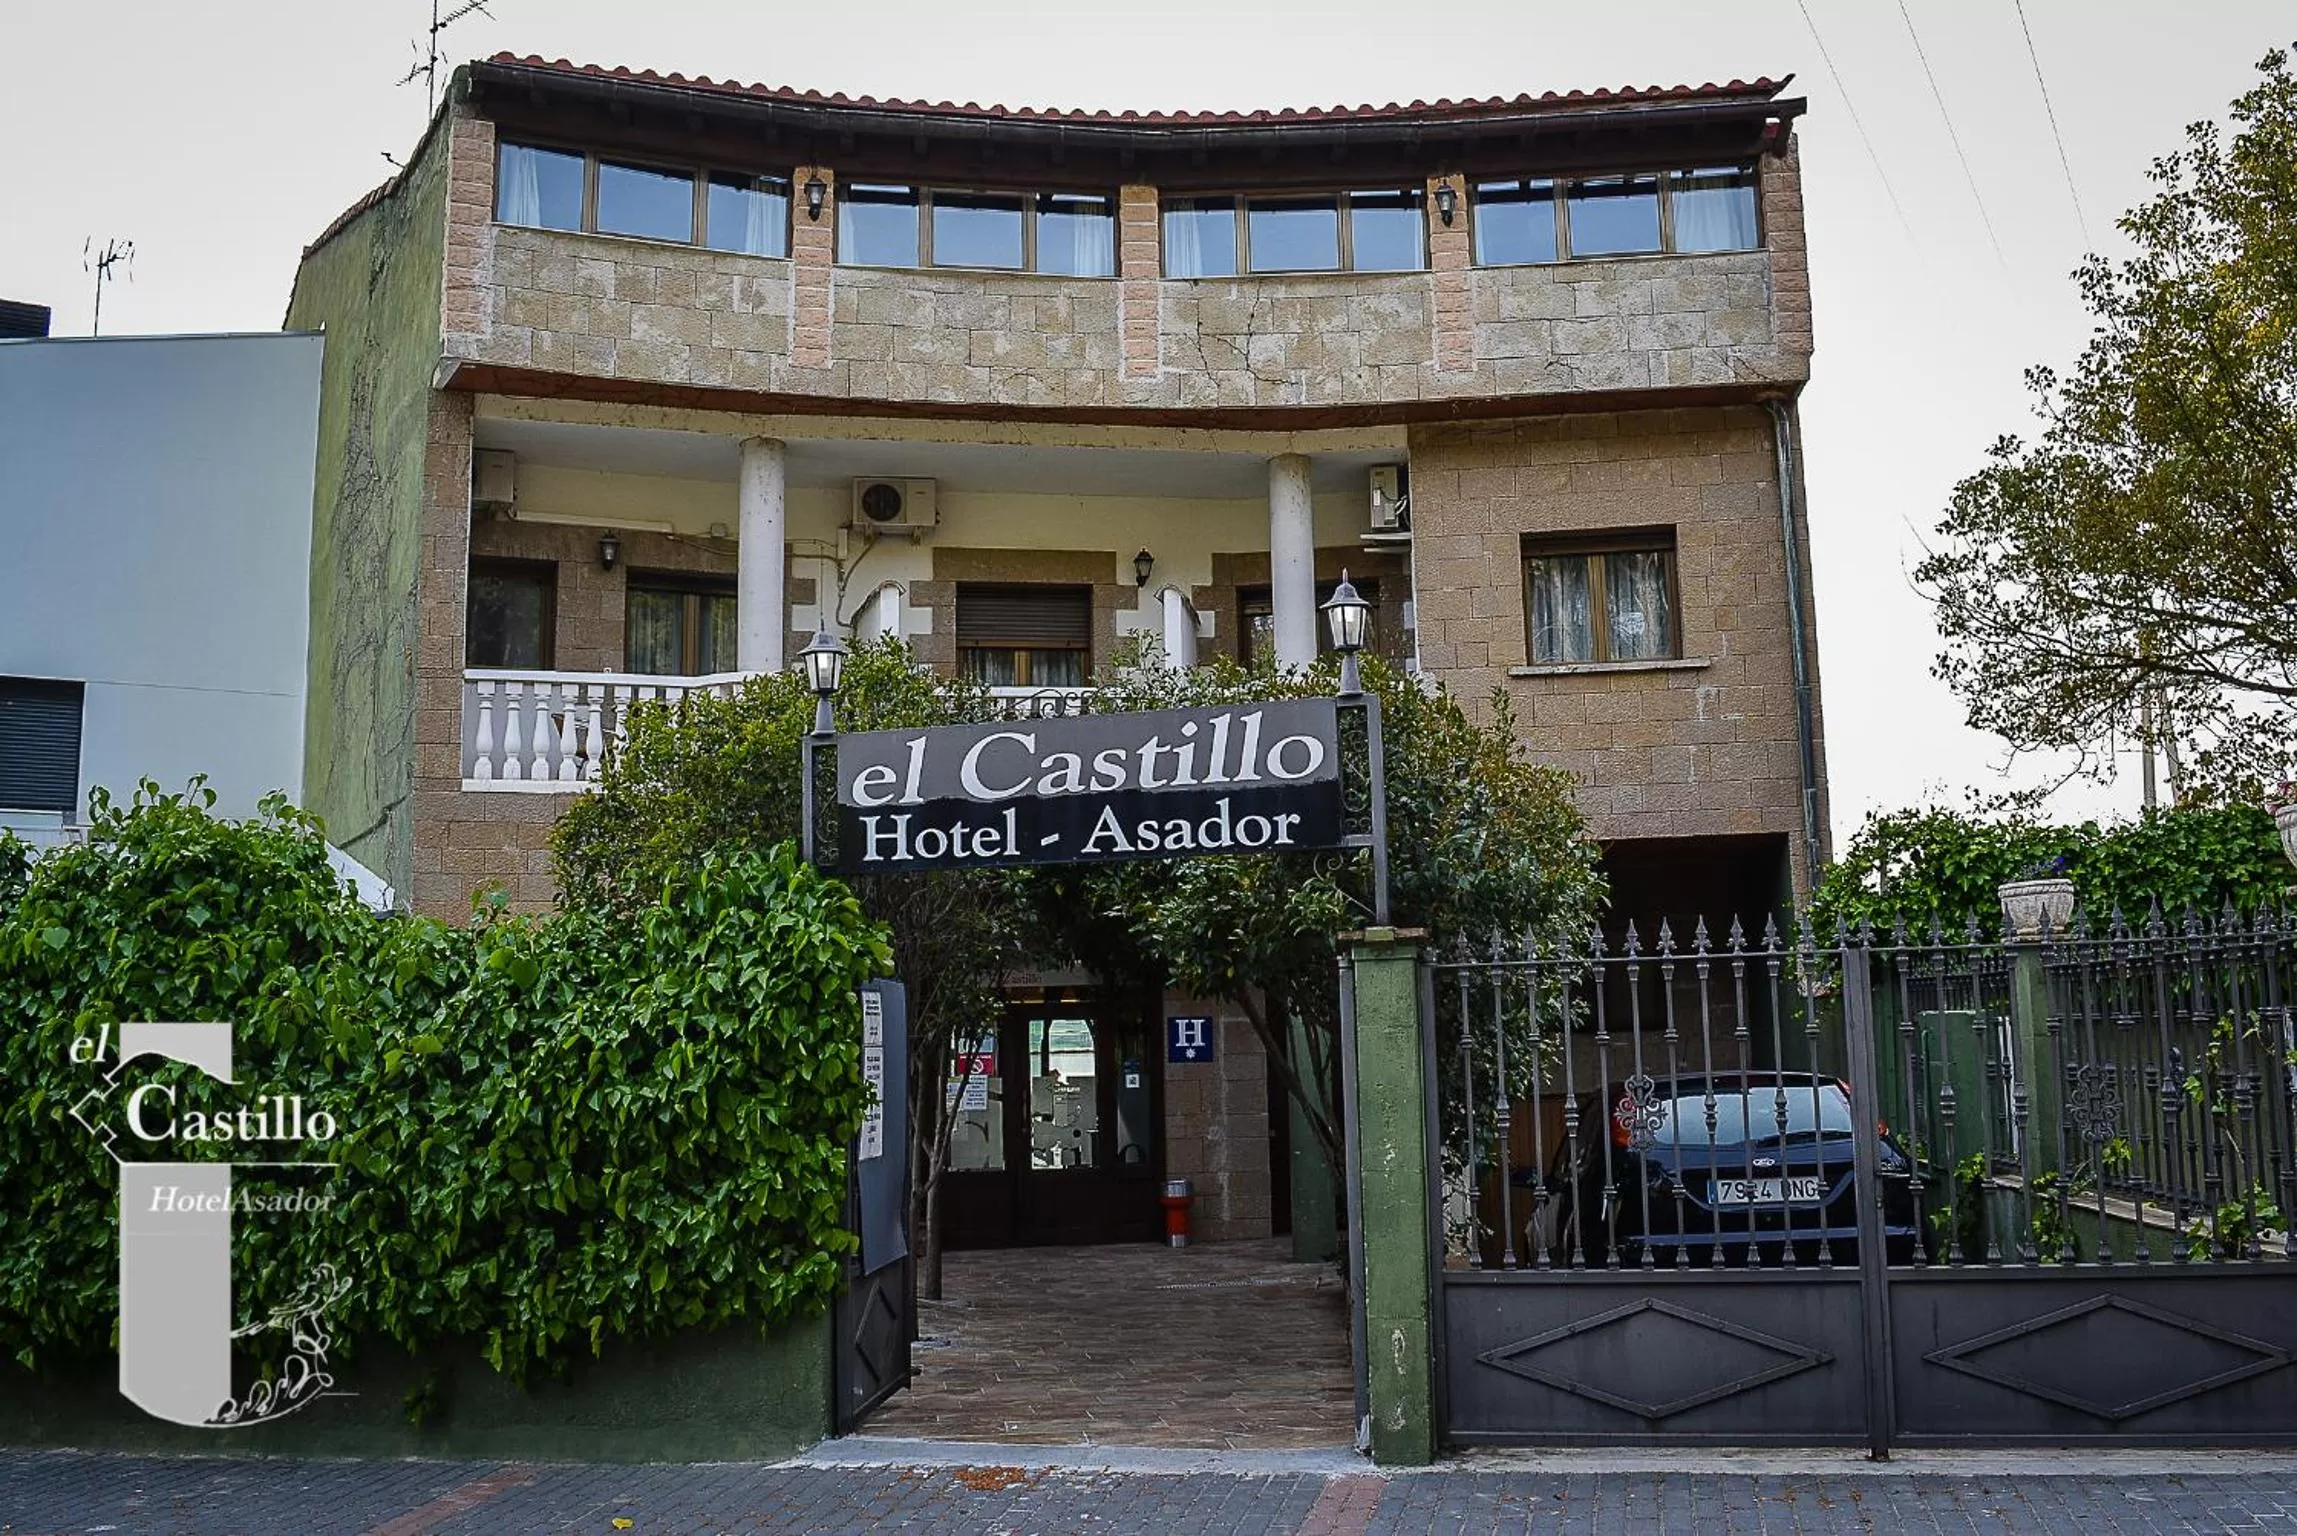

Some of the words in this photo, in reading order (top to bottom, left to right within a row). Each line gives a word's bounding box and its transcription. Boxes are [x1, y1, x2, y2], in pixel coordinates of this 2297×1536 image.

[852, 736, 927, 806] el
[960, 711, 1325, 801] Castillo
[860, 806, 1021, 863] Hotel
[1081, 799, 1300, 855] Asador
[1175, 1019, 1206, 1047] H
